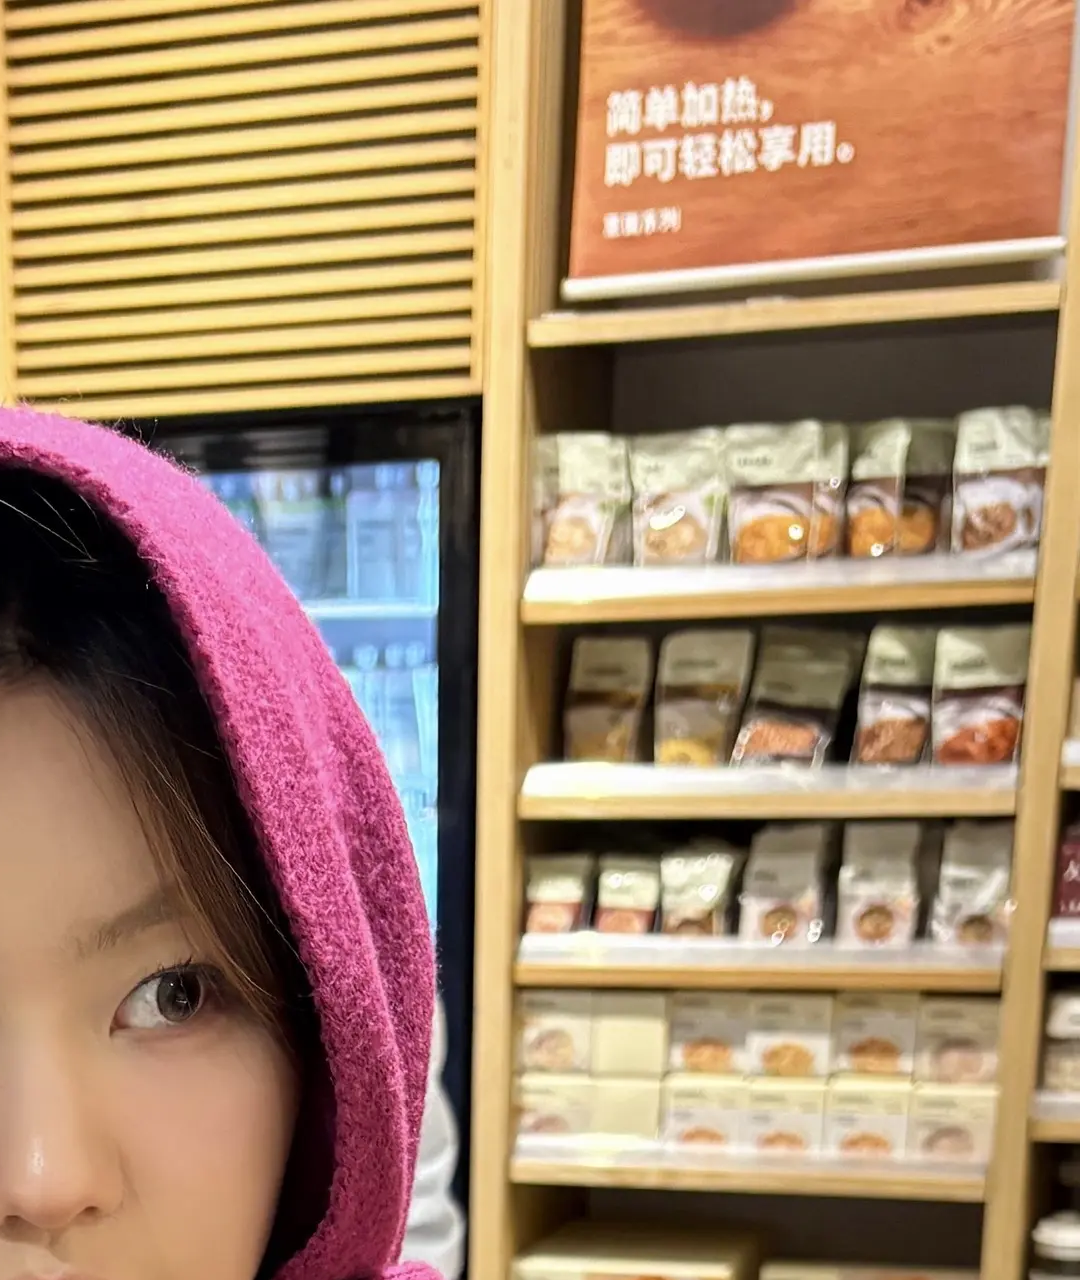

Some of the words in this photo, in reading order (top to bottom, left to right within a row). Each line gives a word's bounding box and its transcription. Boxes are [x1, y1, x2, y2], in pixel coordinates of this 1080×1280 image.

[606, 75, 774, 137] 简单加热，
[604, 121, 855, 188] 即可轻松享用。
